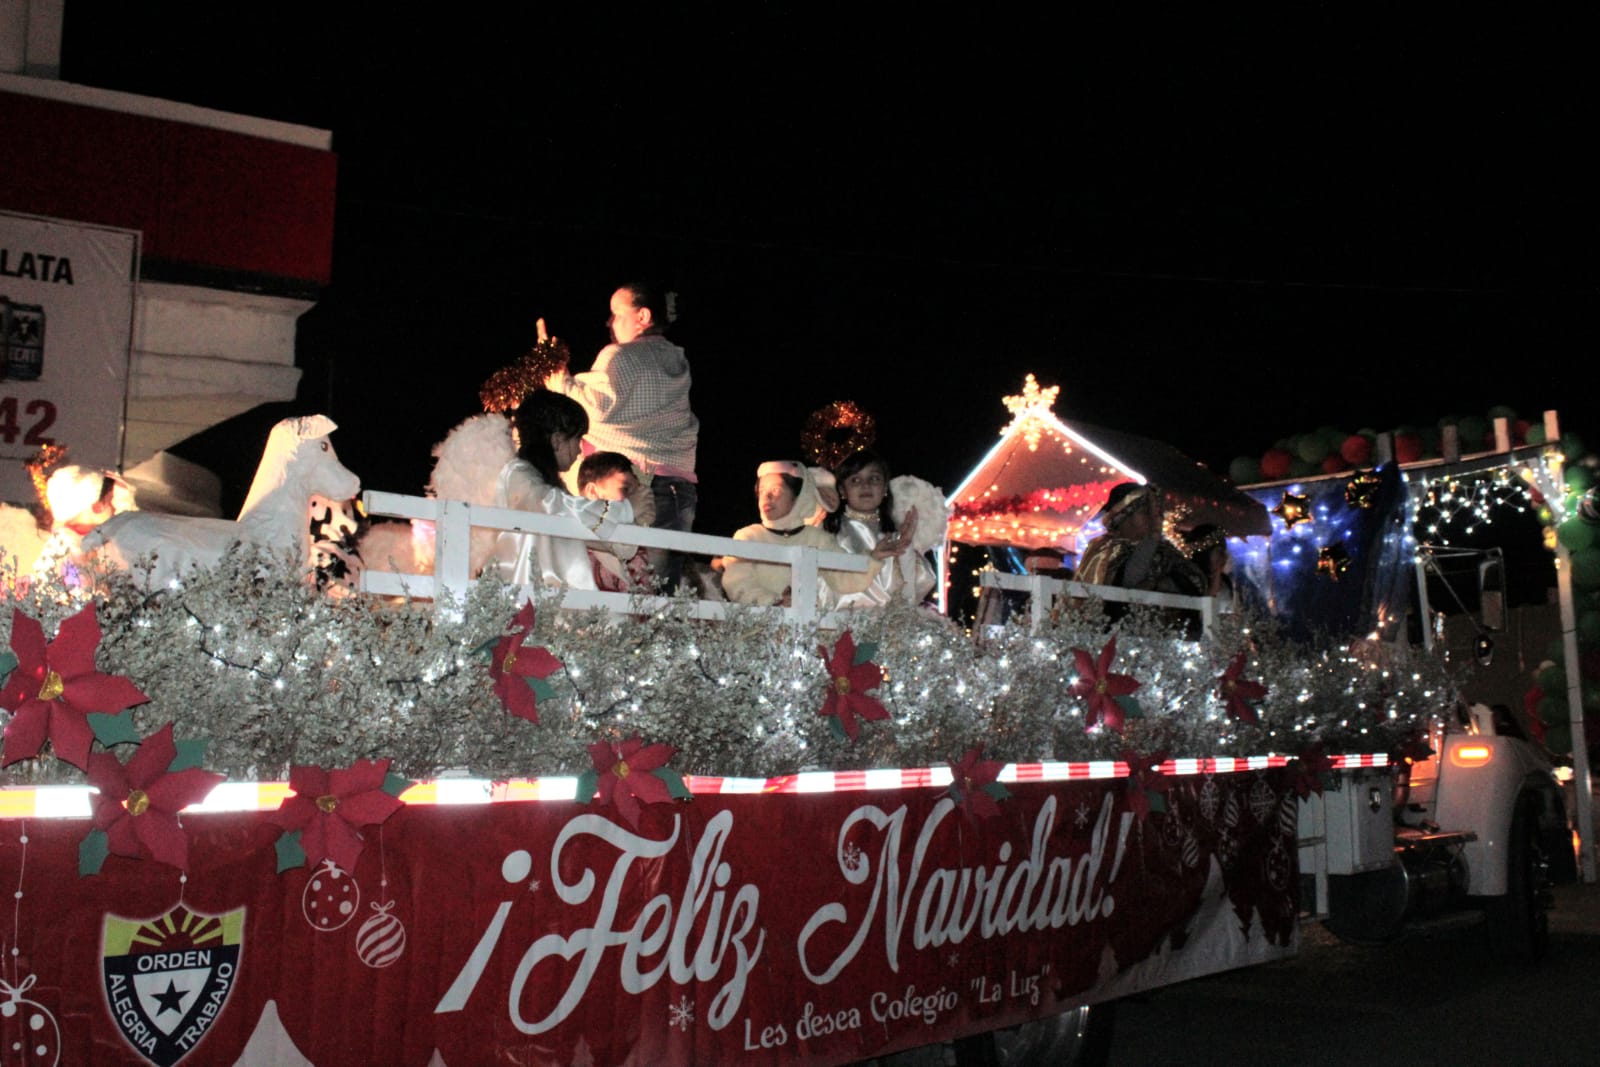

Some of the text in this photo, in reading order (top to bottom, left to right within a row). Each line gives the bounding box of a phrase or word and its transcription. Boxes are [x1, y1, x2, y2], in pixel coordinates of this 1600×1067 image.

[0, 249, 74, 286] LATA
[0, 397, 57, 446] 42
[798, 791, 1134, 985] Navidad!
[137, 950, 211, 972] ORDEN
[109, 974, 158, 1054] ALEGRIA
[175, 962, 234, 1051] TRABAJO
[744, 964, 1051, 1051] Les desea Colegio "La Luz"
